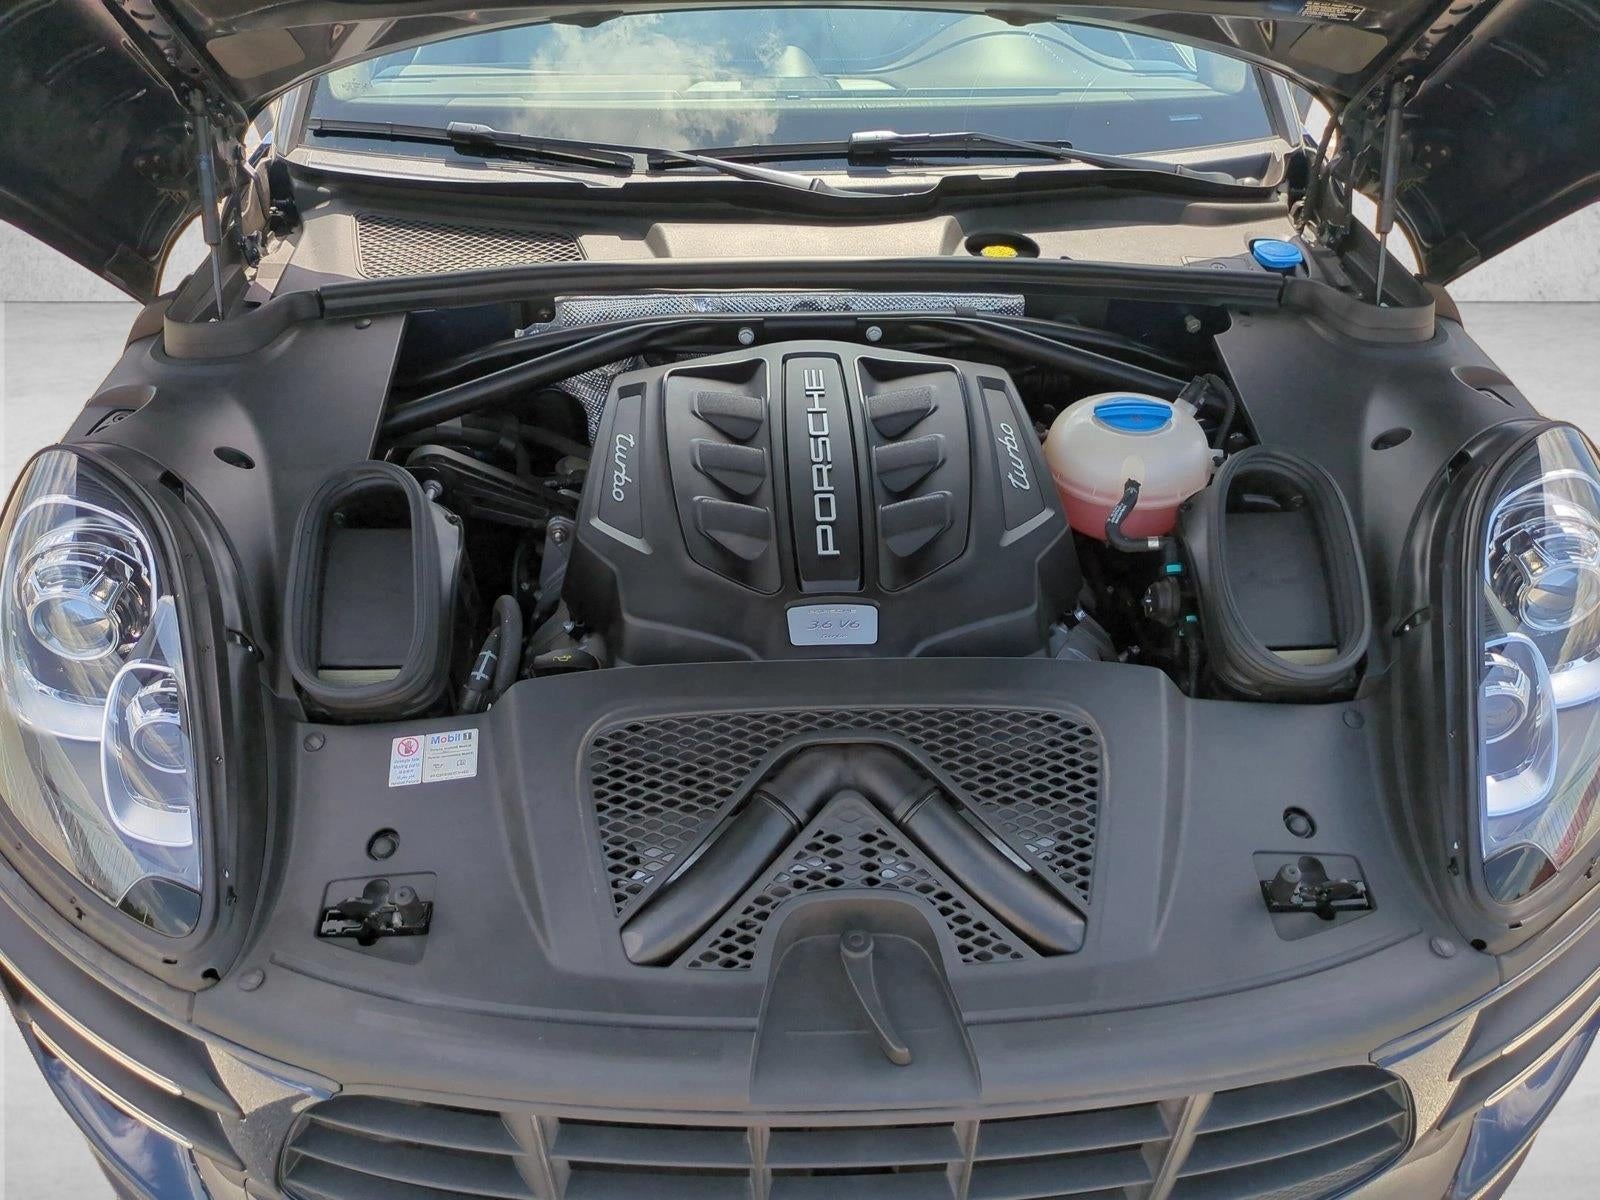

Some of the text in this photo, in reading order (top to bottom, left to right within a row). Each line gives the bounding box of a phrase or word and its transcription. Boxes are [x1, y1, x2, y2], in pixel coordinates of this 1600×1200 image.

[612, 433, 635, 502] turbo
[804, 369, 840, 556] PORSCHE
[997, 422, 1030, 490] turbo
[839, 619, 861, 630] V6
[431, 733, 460, 745] Mobil
